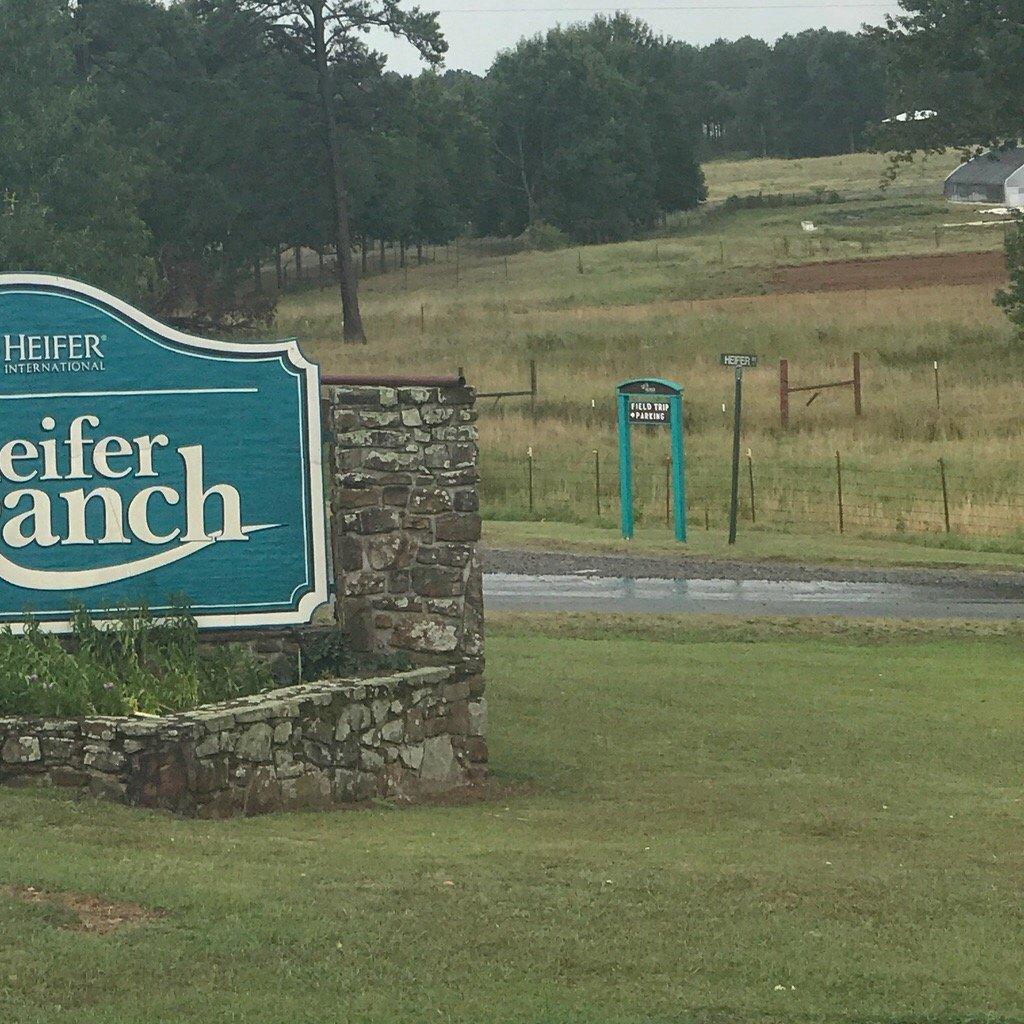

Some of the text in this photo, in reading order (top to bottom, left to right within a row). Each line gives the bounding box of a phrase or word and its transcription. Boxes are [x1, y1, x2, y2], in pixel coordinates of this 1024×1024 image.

[4, 334, 103, 362] HEIFER
[724, 355, 751, 365] HEIFER
[4, 362, 106, 374] INTERNATIONAL
[654, 403, 669, 411] TRIP
[636, 412, 665, 420] PARKING
